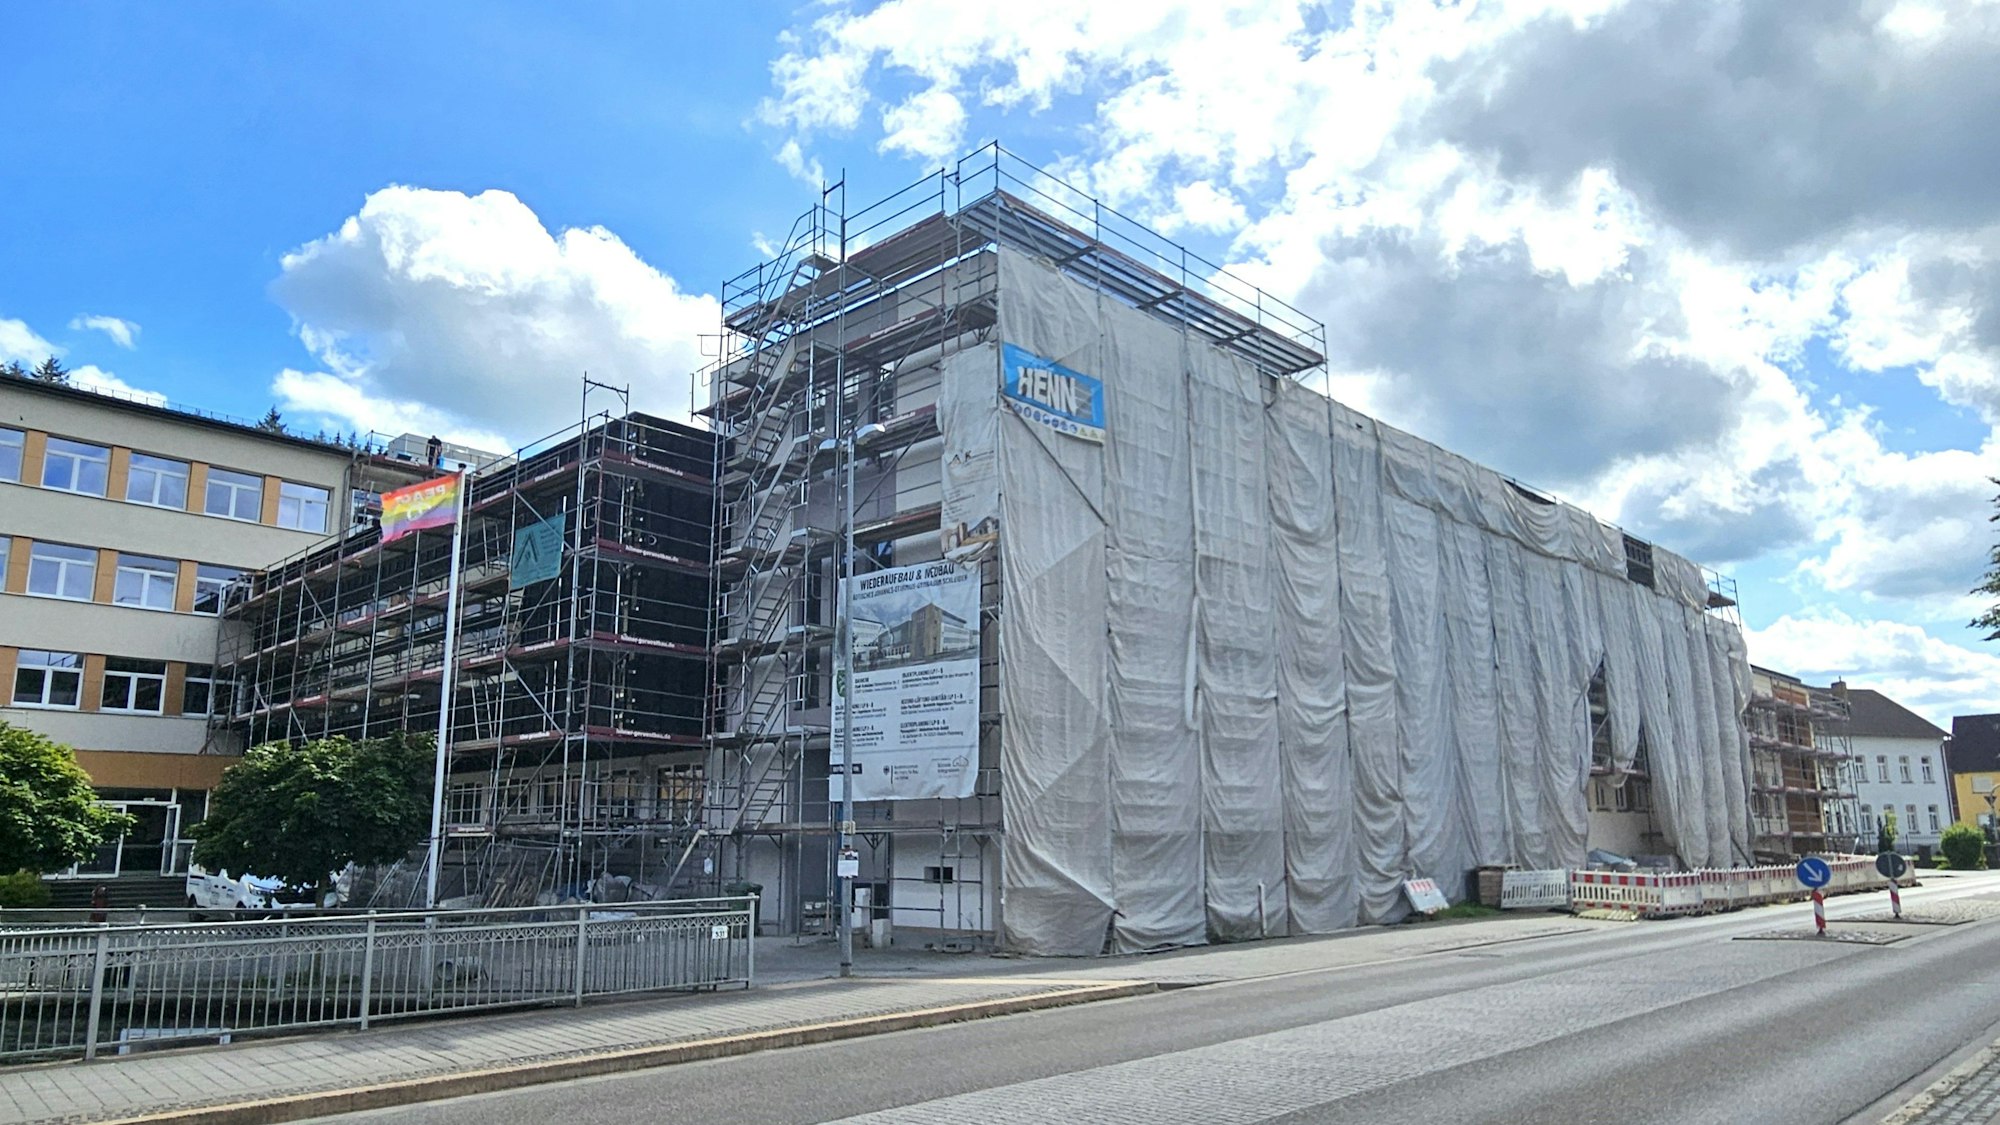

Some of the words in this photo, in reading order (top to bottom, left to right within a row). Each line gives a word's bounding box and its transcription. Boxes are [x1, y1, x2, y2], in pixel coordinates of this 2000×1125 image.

[860, 570, 915, 591] WIEDERAUFBAU
[915, 569, 922, 580] &
[925, 563, 955, 579] NEUBAU
